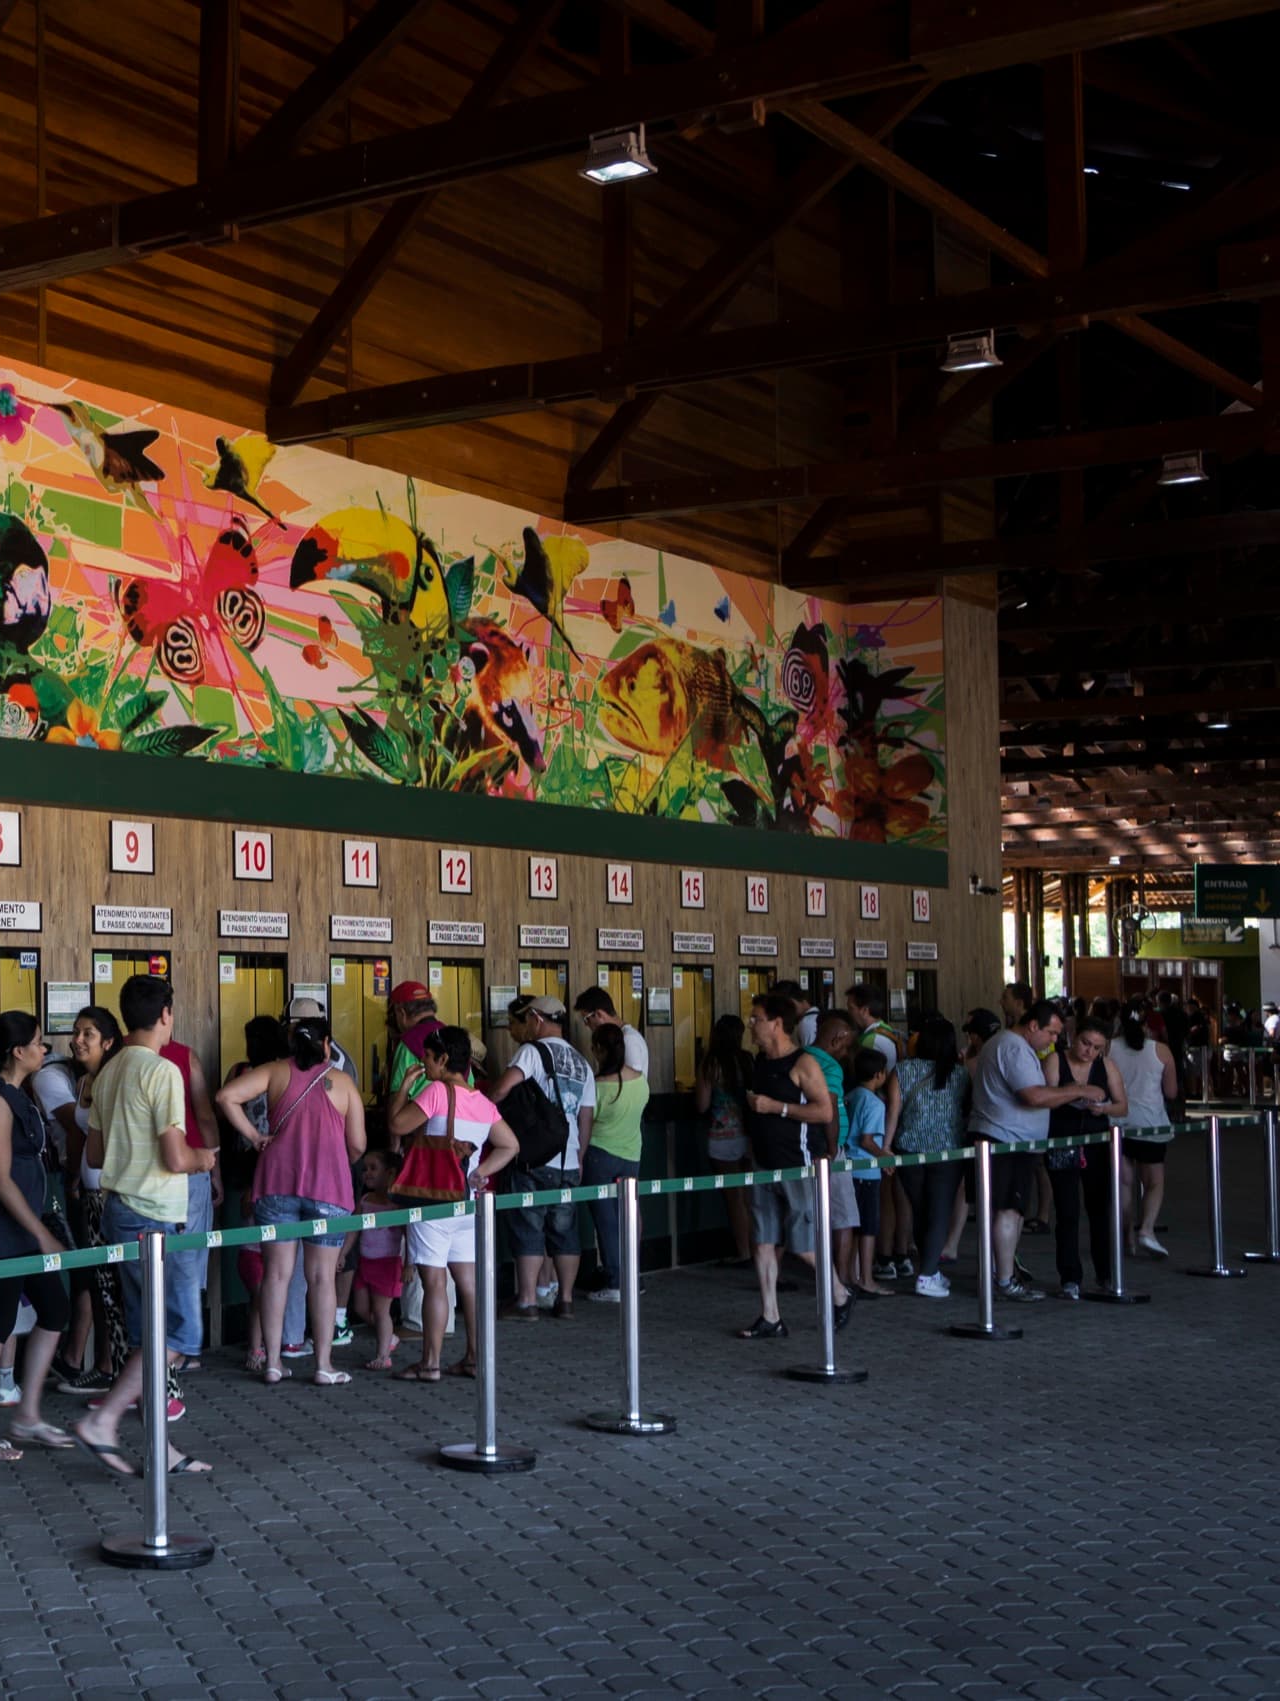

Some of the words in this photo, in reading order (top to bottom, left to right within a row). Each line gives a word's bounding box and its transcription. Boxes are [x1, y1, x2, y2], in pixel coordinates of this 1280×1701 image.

[124, 830, 140, 864] 9
[240, 840, 266, 873] 10
[351, 849, 370, 879] 11
[446, 857, 466, 886] 12
[534, 865, 553, 892] 13
[611, 871, 629, 897] 14
[684, 877, 701, 902] 15
[1203, 879, 1248, 889] ENTRADA
[750, 882, 765, 907] 16
[809, 887, 823, 911] 17
[863, 891, 876, 914] 18
[915, 895, 928, 918] 19
[96, 909, 137, 918] ATENDIMENTO
[138, 911, 170, 920] VISITANTES
[107, 920, 126, 929] PASSE
[127, 921, 165, 930] COMUNIDADE
[22, 953, 37, 963] VISA
